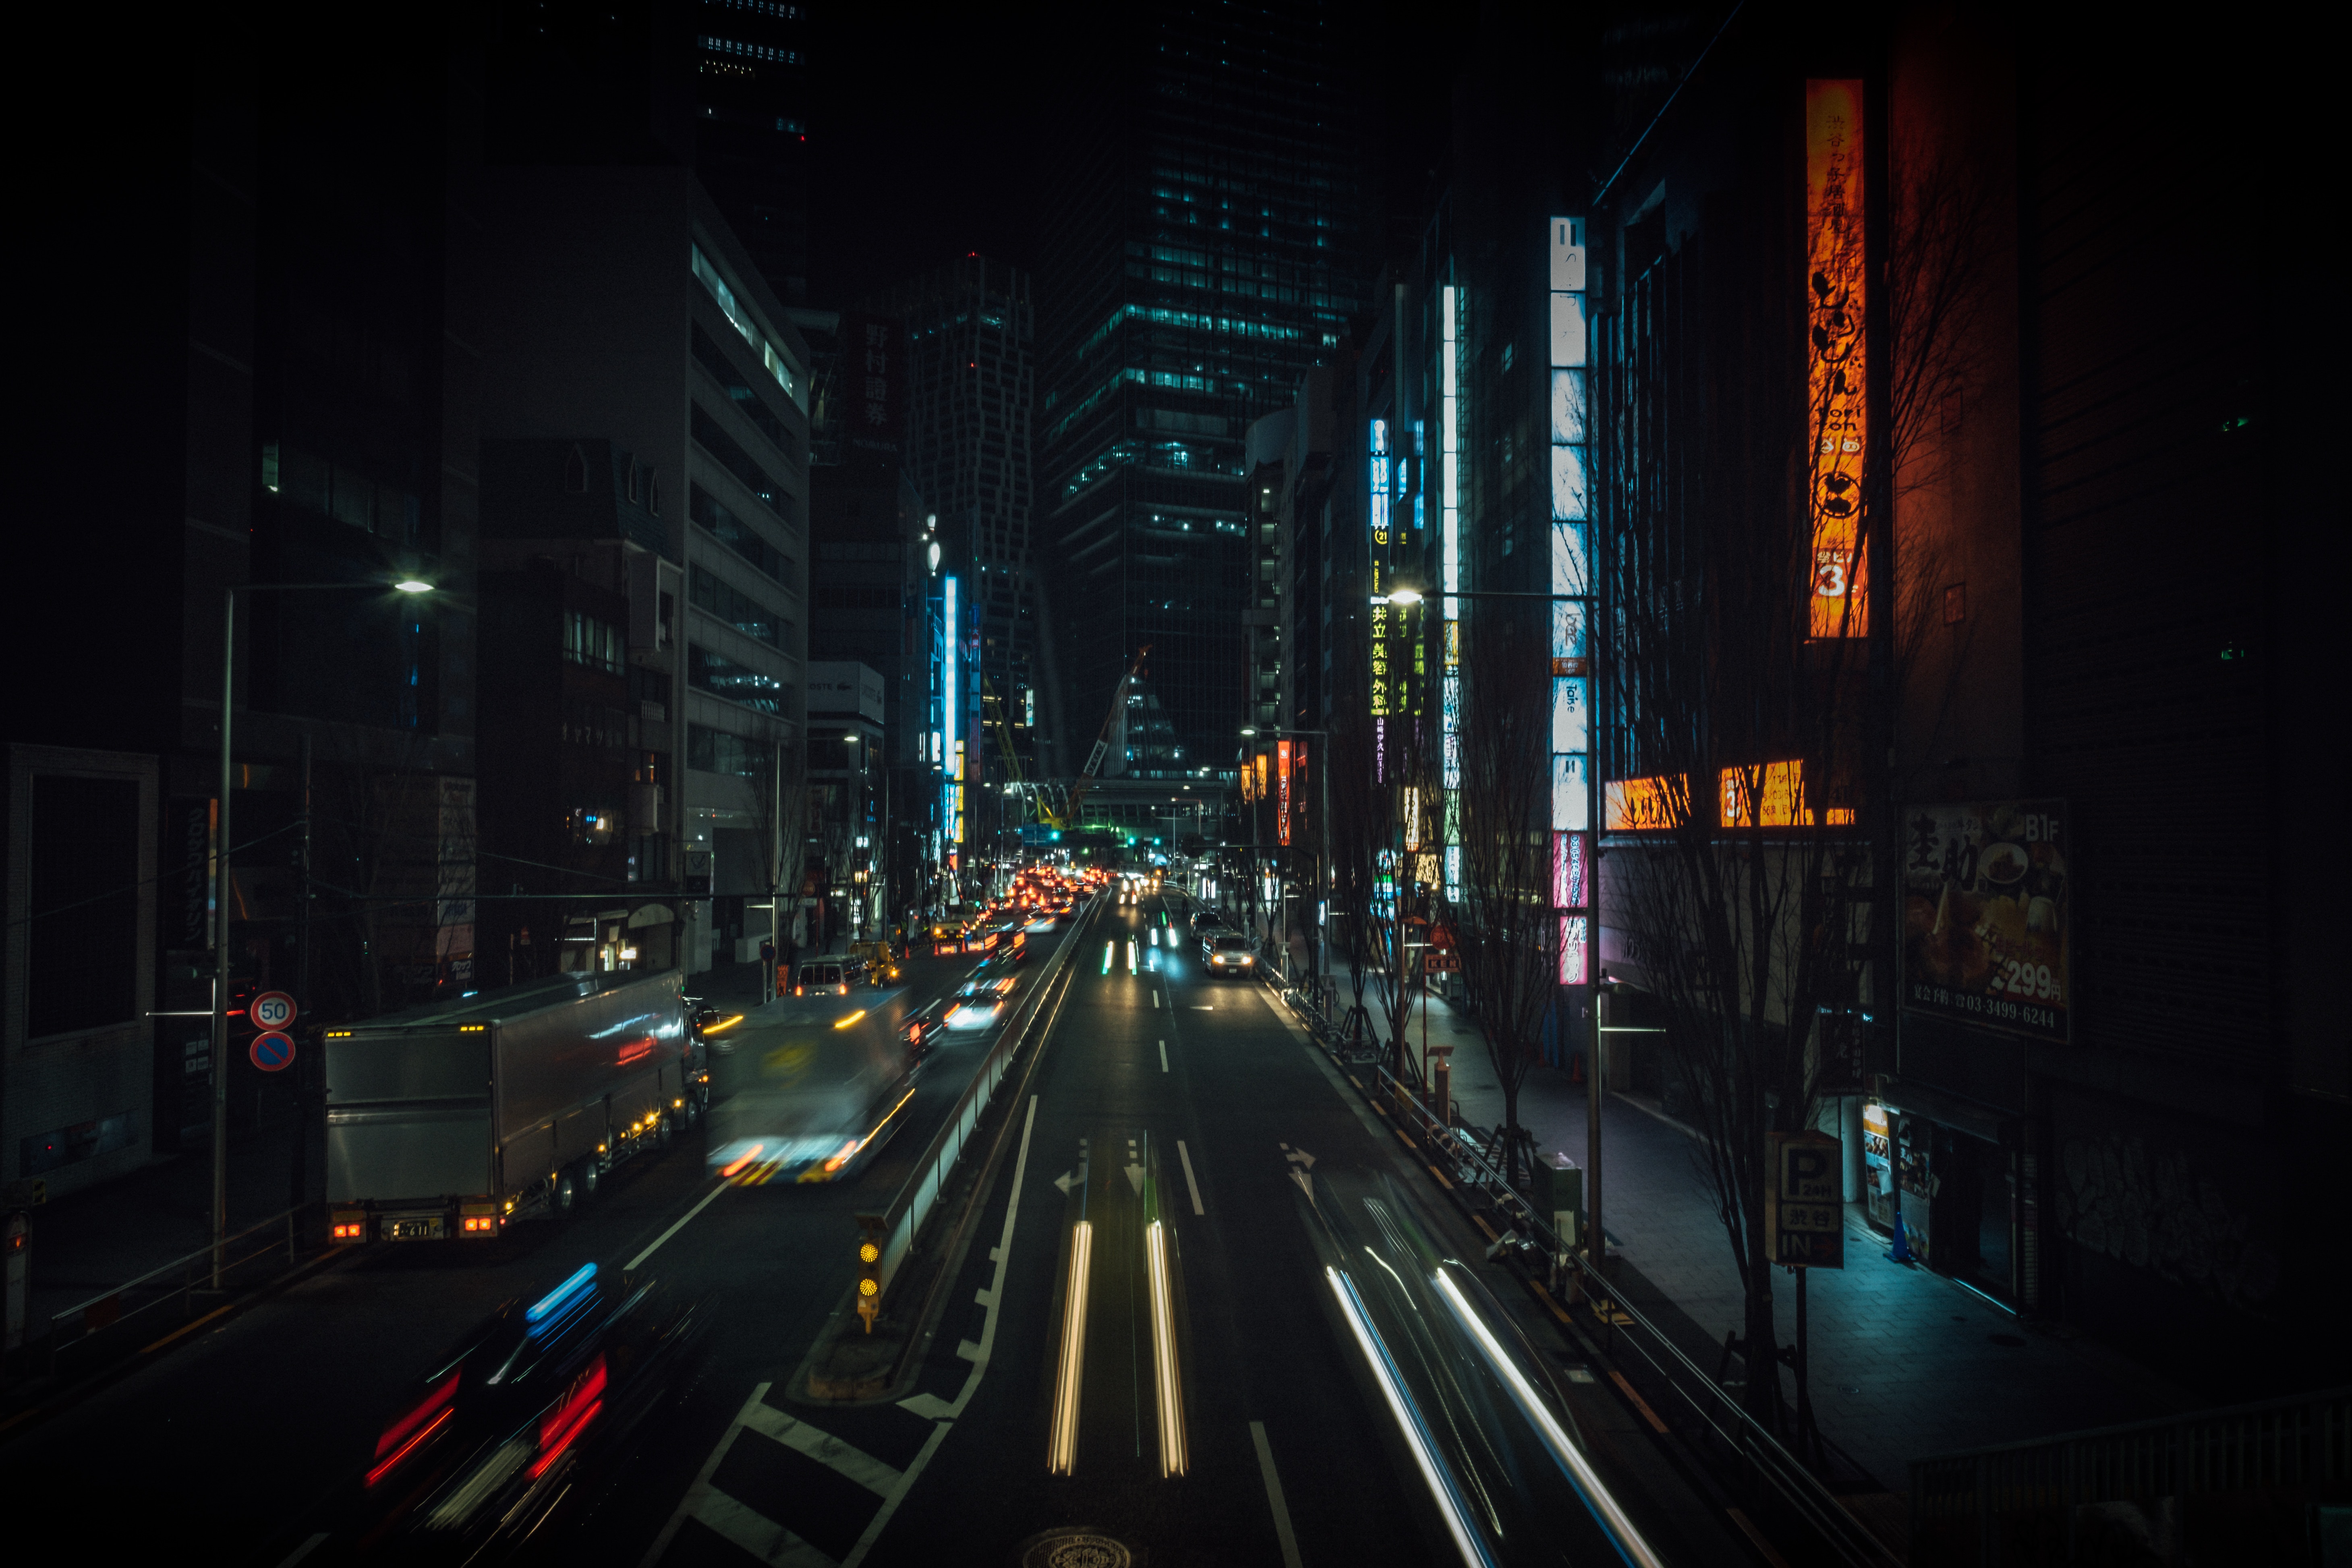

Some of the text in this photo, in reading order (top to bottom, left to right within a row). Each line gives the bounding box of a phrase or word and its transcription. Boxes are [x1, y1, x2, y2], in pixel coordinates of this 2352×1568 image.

[2025, 814, 2059, 843] B1F
[262, 1003, 286, 1019] 50
[1967, 995, 2054, 1028] 03-3499-6244
[1788, 1149, 1827, 1195] P
[1803, 1185, 1832, 1197] 24H
[1789, 1209, 1830, 1227] 渋谷
[1782, 1234, 1811, 1256] IN
